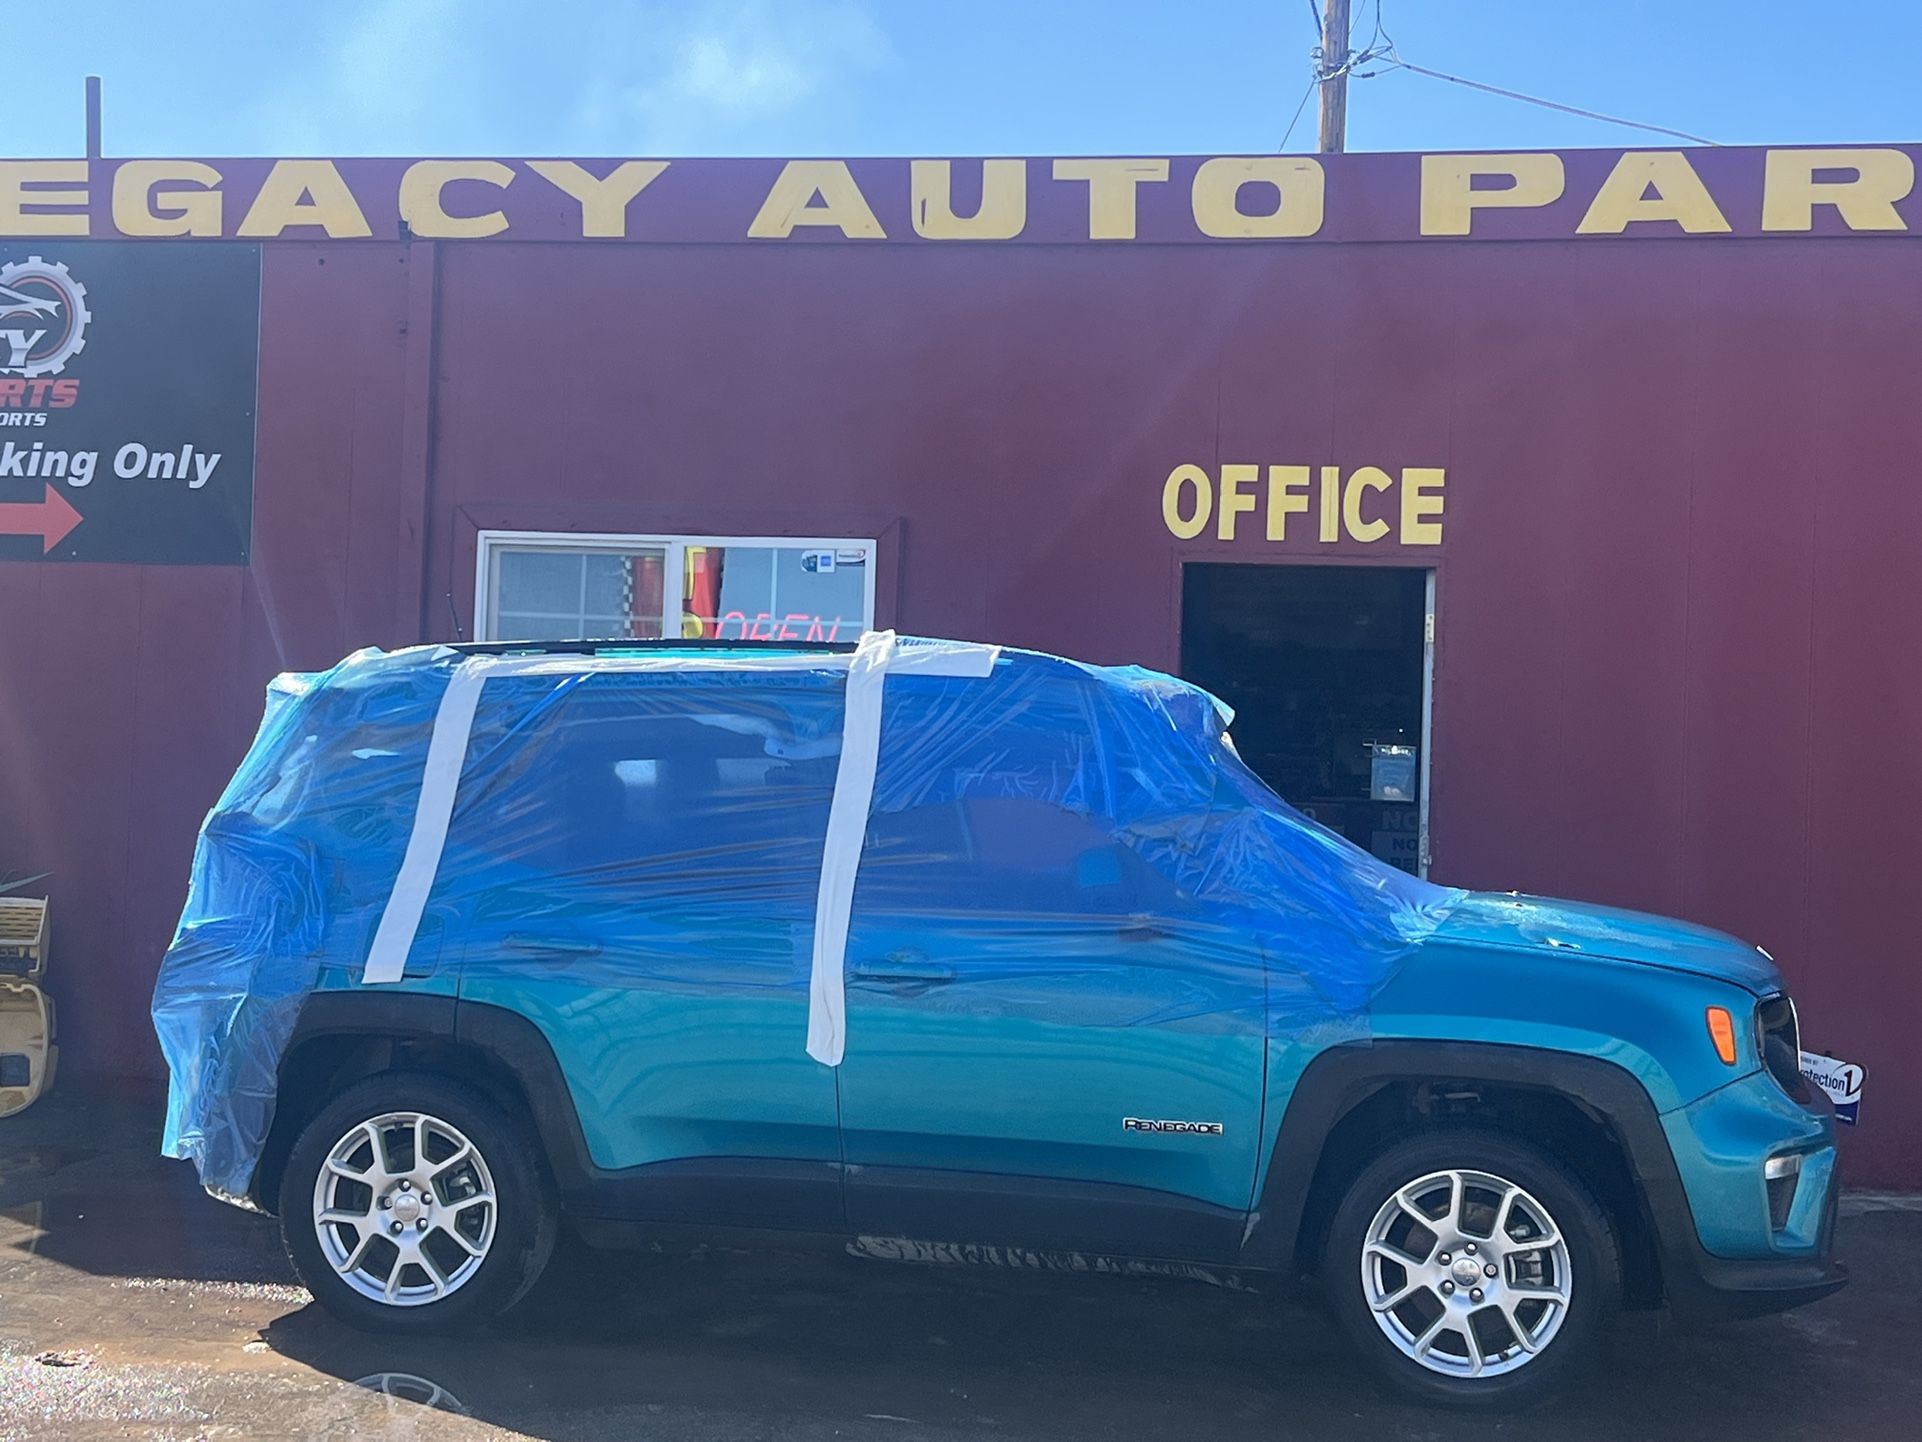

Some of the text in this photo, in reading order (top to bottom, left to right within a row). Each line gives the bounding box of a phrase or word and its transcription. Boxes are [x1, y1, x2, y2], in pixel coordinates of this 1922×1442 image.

[0, 149, 1915, 239] EGACY AUTO PAR
[0, 441, 222, 489] king Only
[1162, 464, 1445, 545] OFFICE
[1123, 1117, 1223, 1135] RENEGADE
